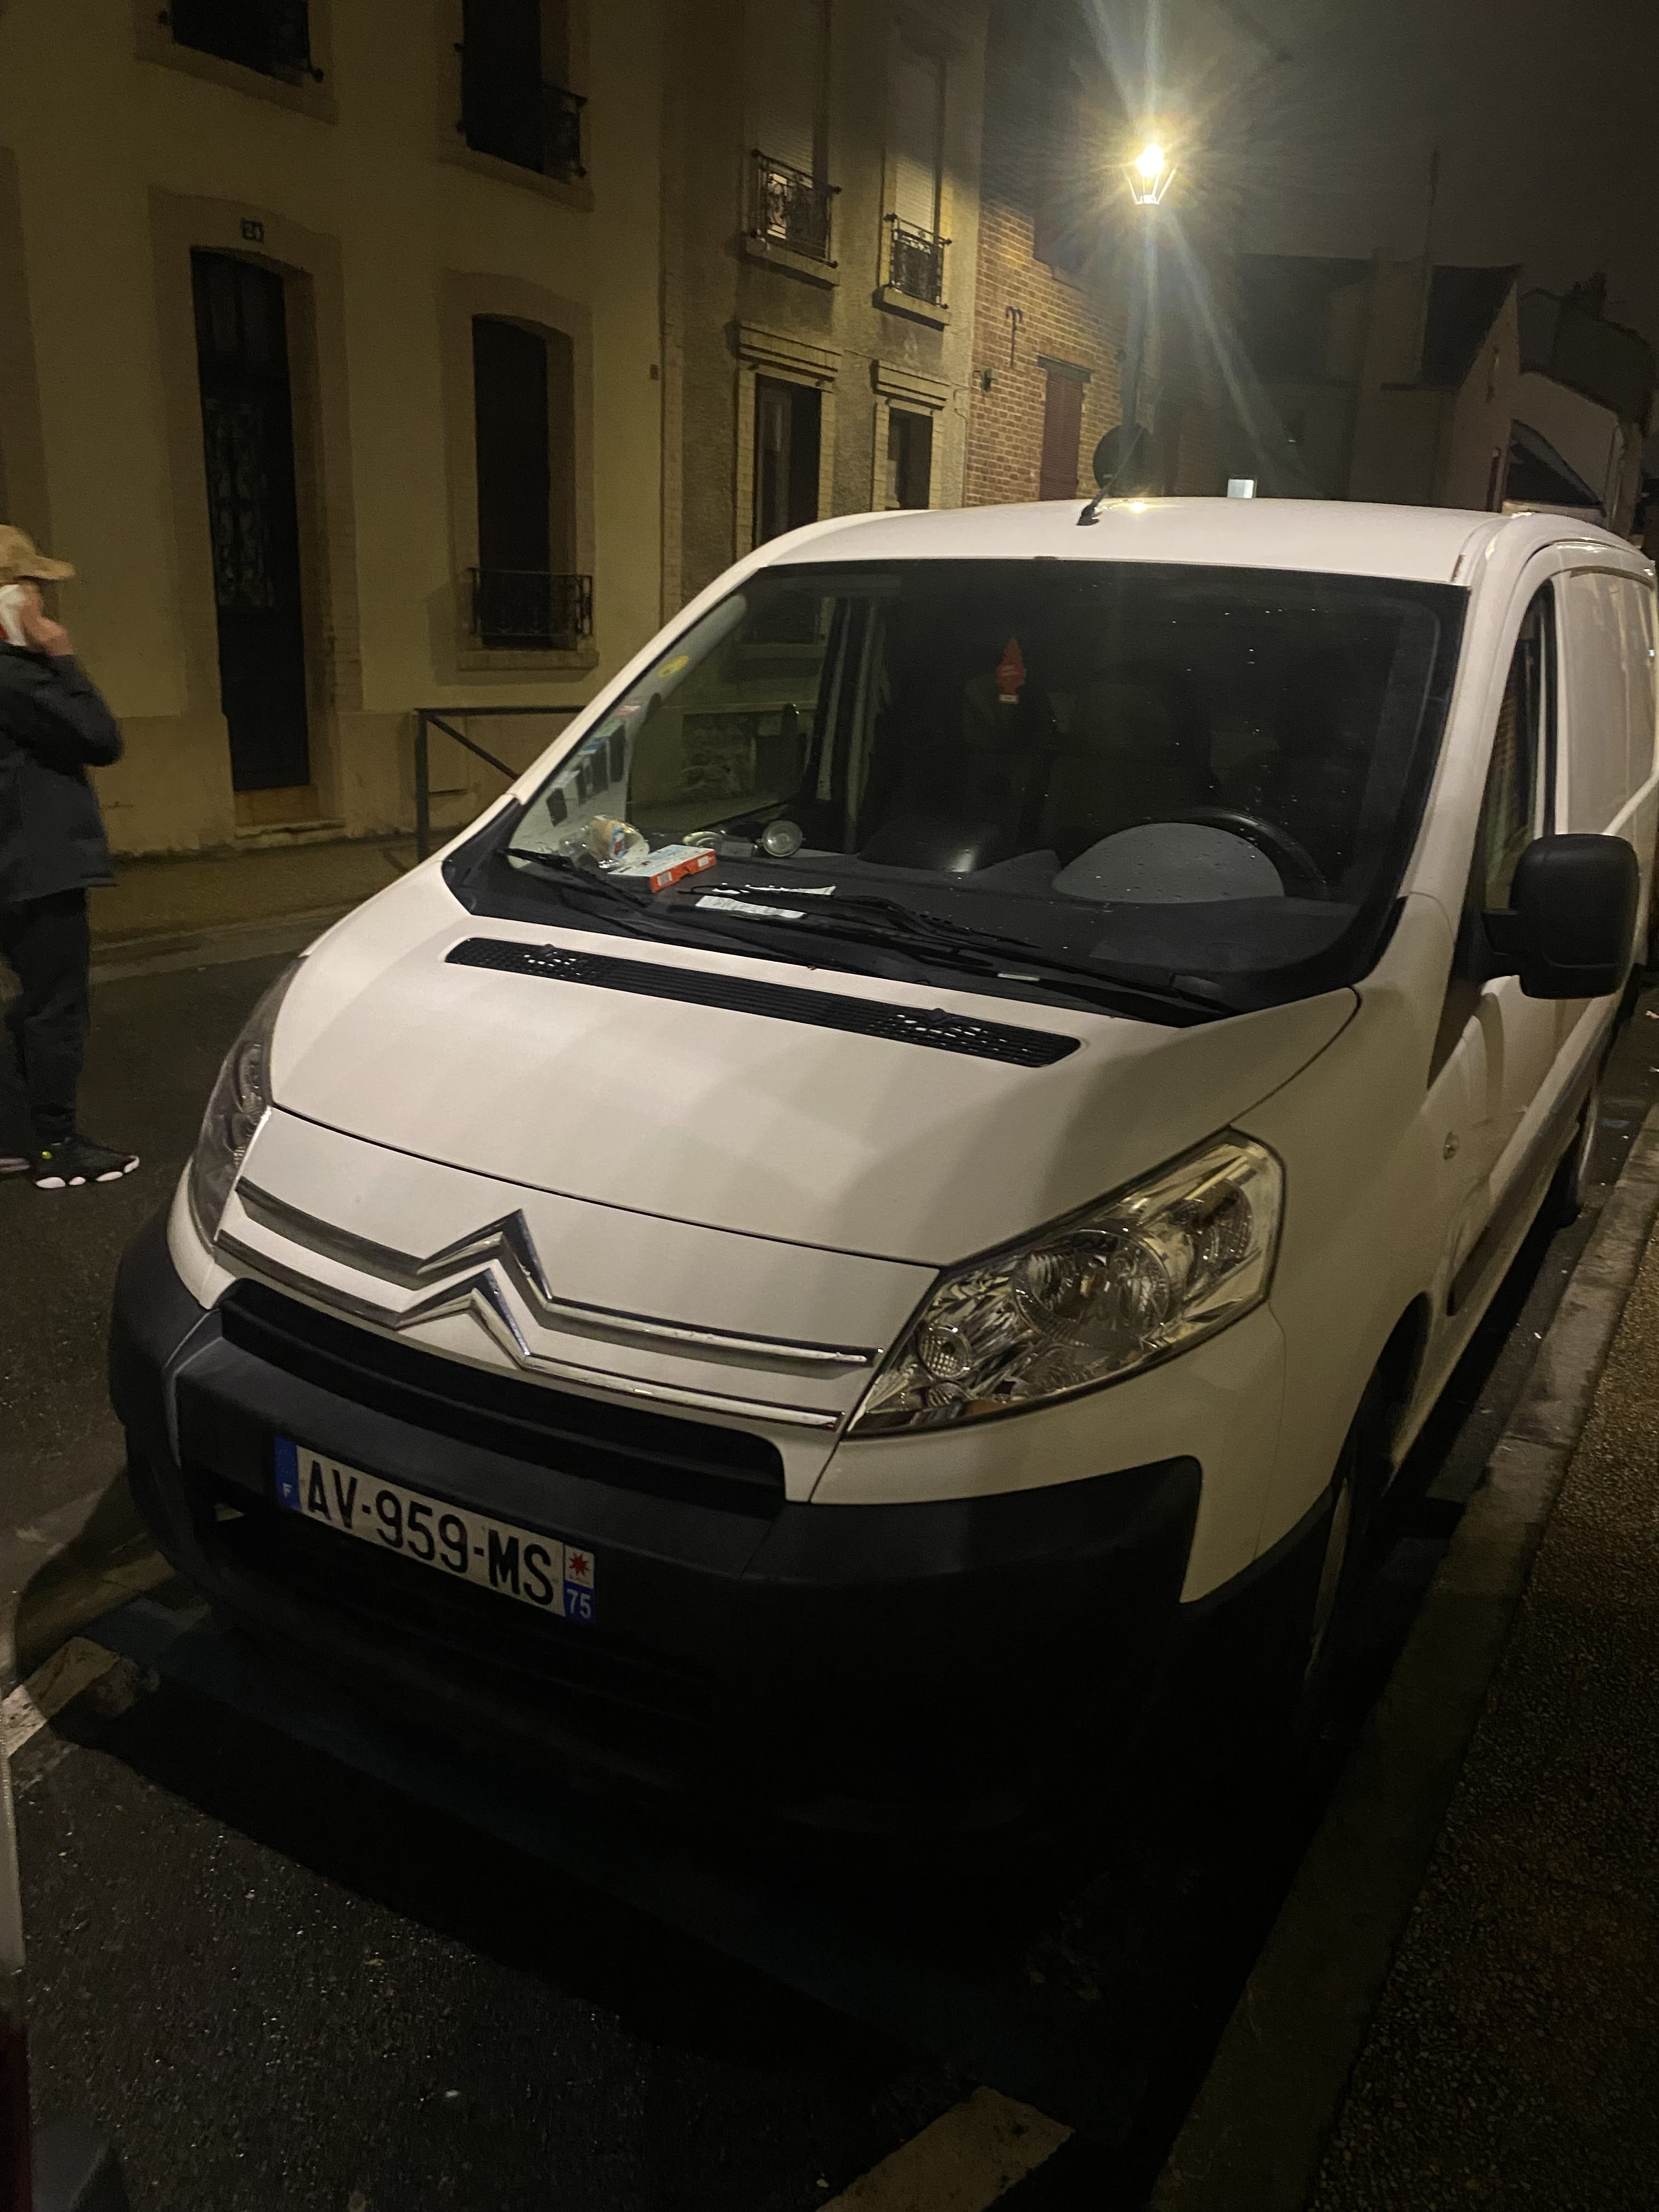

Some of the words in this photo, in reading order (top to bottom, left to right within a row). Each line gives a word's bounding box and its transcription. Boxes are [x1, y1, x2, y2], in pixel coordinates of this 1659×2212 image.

[282, 1482, 292, 1497] F
[307, 1460, 553, 1605] AV-959-MS
[566, 1588, 591, 1620] 75
